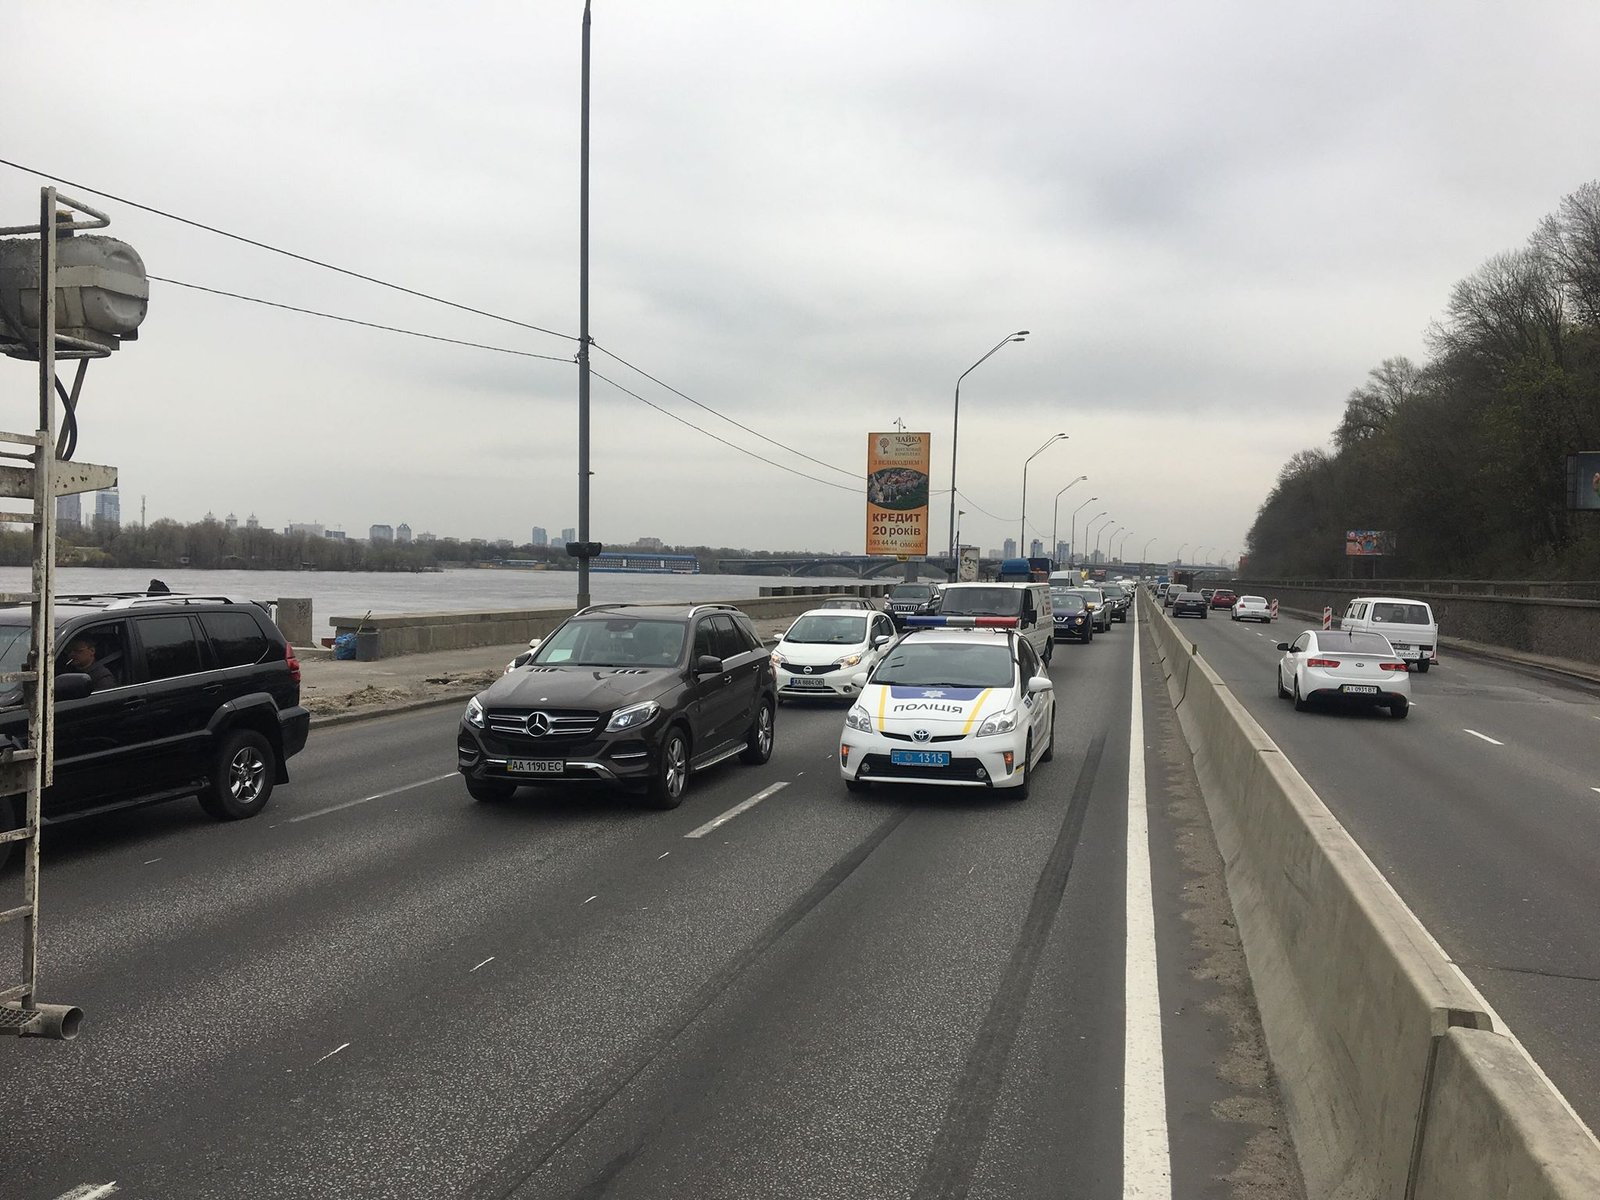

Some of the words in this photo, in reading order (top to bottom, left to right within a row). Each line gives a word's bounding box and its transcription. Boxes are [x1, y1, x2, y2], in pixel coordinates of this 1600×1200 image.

[895, 434, 922, 443] ЧАЙКА
[872, 513, 921, 523] КРЕДИТ
[872, 526, 887, 535] 20
[889, 525, 921, 537] років
[893, 703, 963, 714] ПОЛІЦІЯ
[918, 753, 943, 763] 1315
[512, 760, 525, 770] AA
[526, 761, 546, 771] 1190
[547, 761, 562, 771] EC
